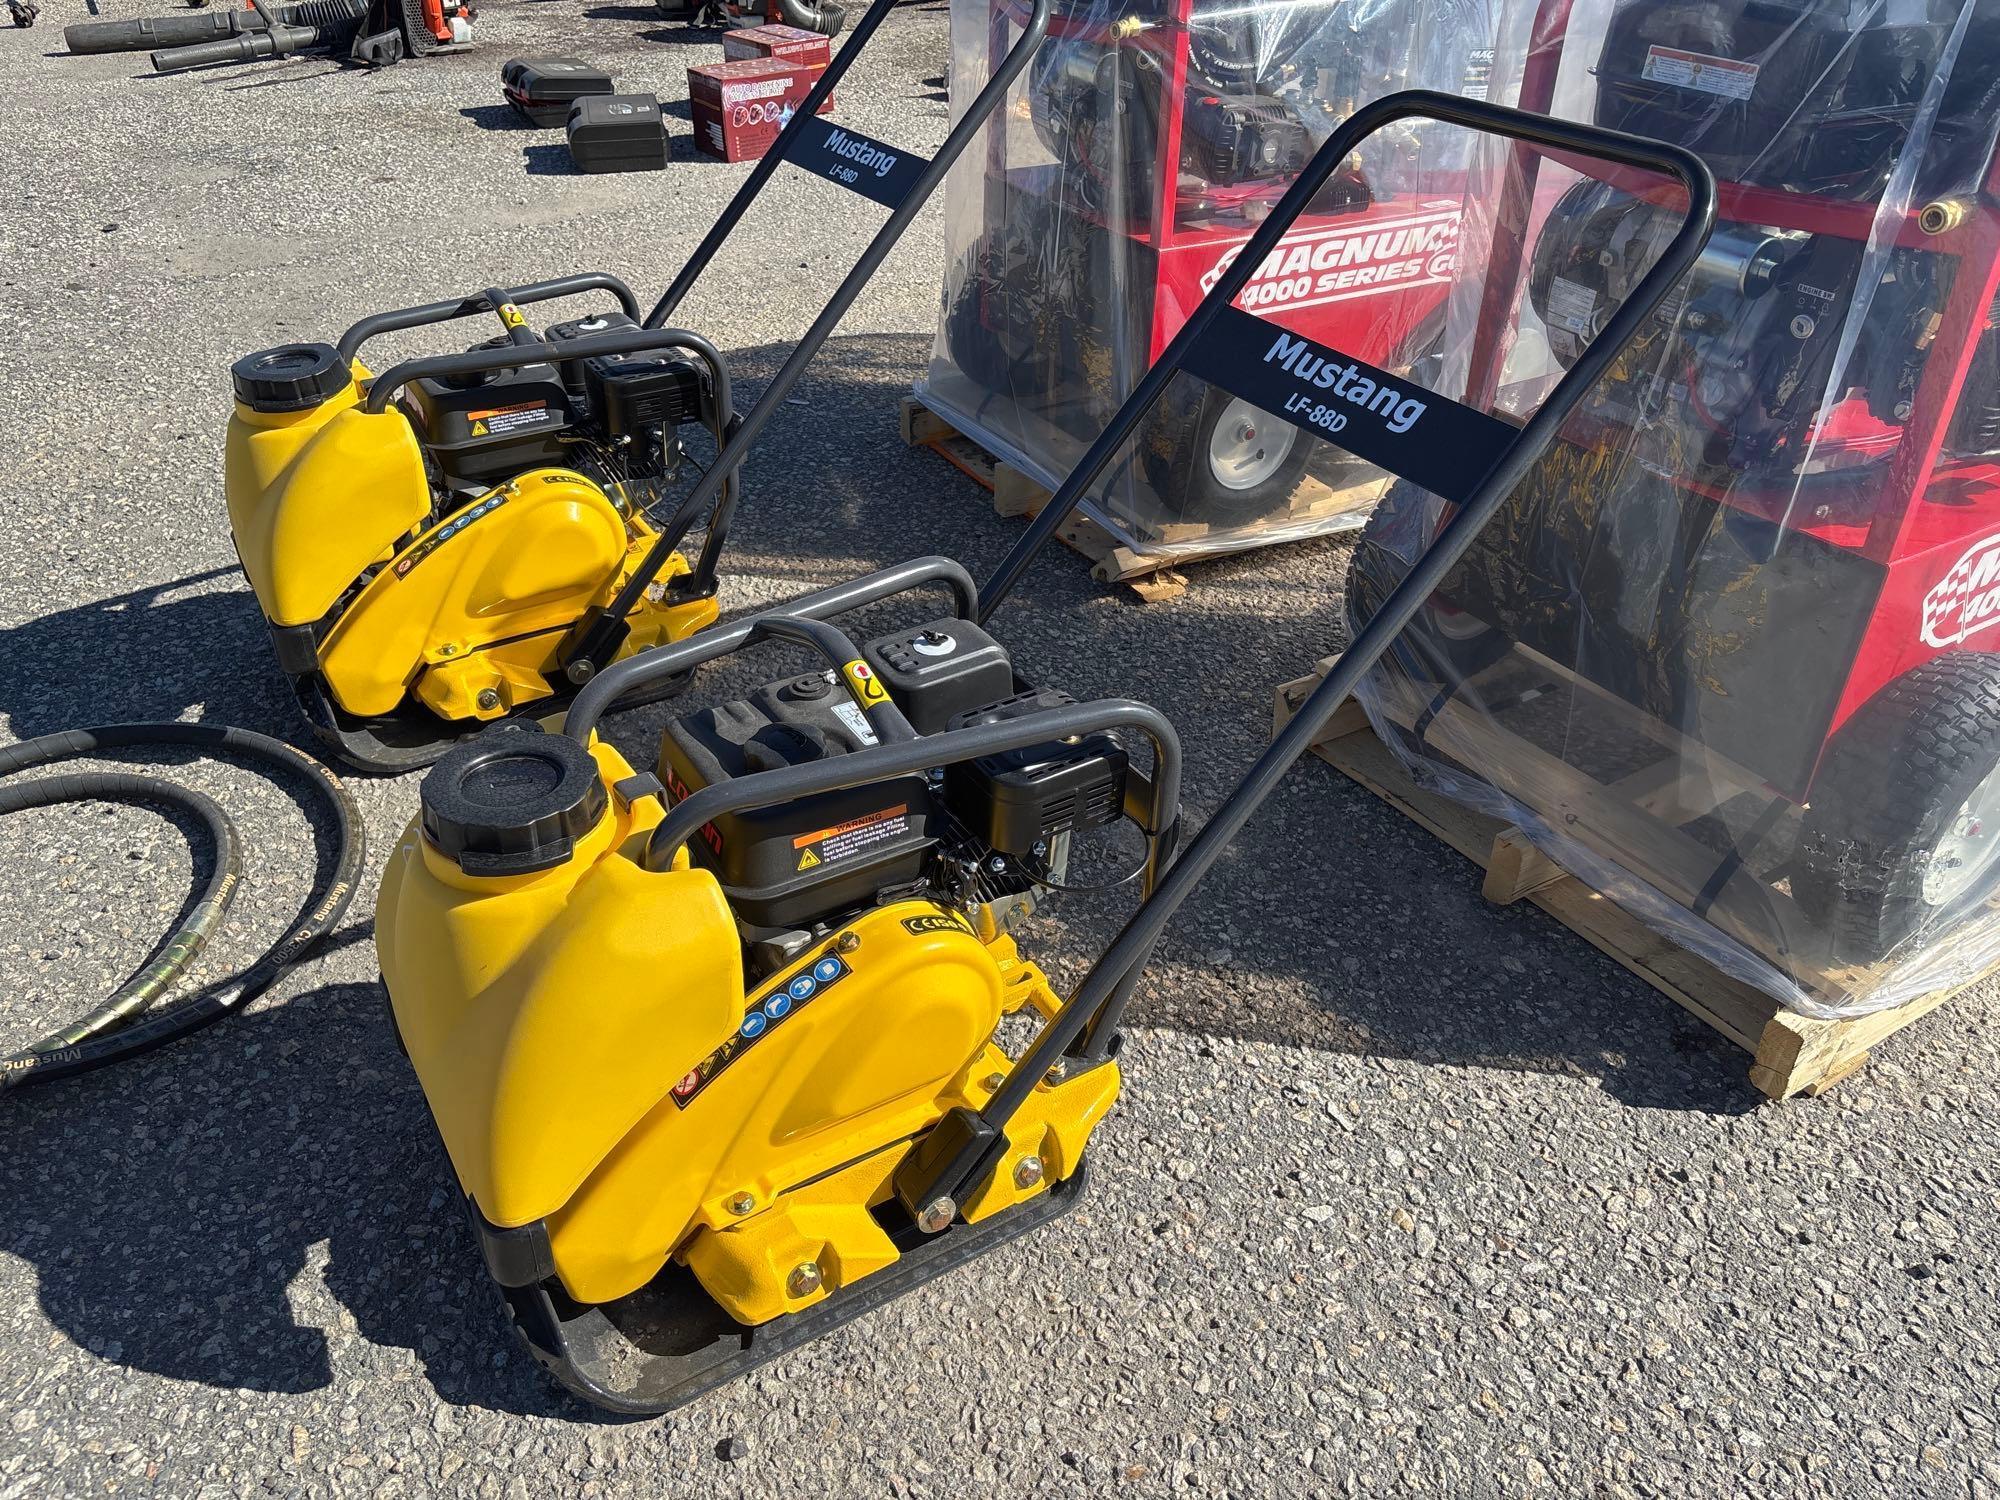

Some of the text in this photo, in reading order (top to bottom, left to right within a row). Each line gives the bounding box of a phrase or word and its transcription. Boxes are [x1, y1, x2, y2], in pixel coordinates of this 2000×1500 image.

[823, 129, 897, 177] Mustang
[829, 163, 858, 183] LF-88D
[1240, 276, 1312, 307] 4000
[1314, 258, 1424, 293] SERIES
[1263, 332, 1428, 433] Mustang
[1284, 392, 1348, 433] LF-88D
[836, 813, 882, 833] WARNING
[212, 873, 237, 907] Mustan
[273, 882, 349, 964] Mustang CV3500
